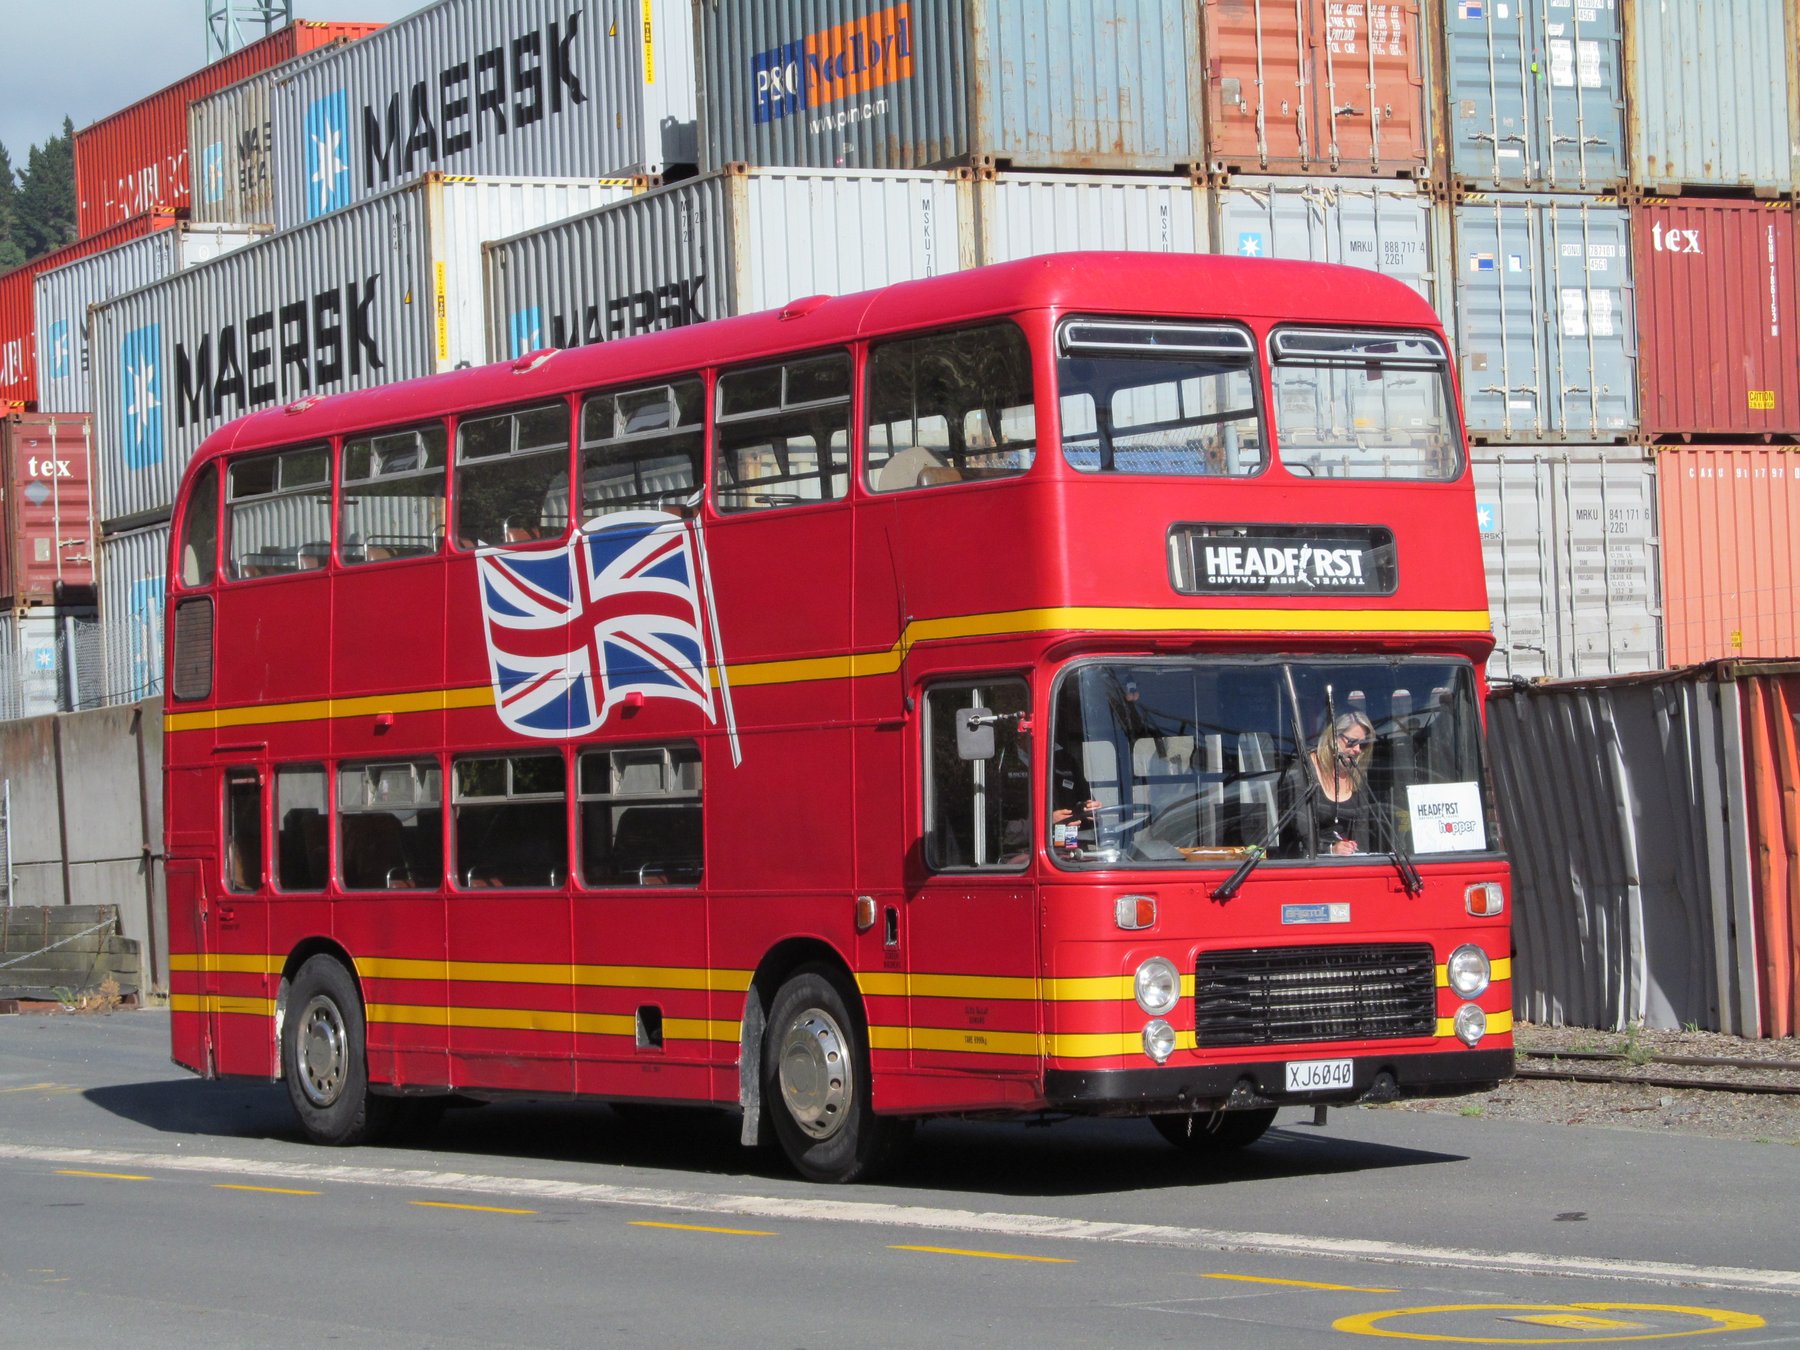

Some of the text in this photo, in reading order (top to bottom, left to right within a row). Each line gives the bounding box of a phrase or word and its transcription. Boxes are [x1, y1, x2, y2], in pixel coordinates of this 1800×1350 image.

[757, 61, 799, 105] P&O
[365, 10, 588, 188] MAERSK
[922, 199, 930, 250] MSKU
[1652, 220, 1701, 253] tex
[1350, 241, 1373, 252] MRKU
[1385, 254, 1404, 265] 22G1
[554, 275, 706, 349] MAERSK
[176, 273, 384, 427] MAERSK
[28, 456, 71, 477] tex
[1576, 509, 1599, 520] MRKU
[1609, 509, 1623, 520] 841
[1626, 509, 1640, 520] 171
[1610, 522, 1628, 533] 22G1
[1439, 820, 1476, 836] hopper
[1290, 1063, 1351, 1088] XJ6040
